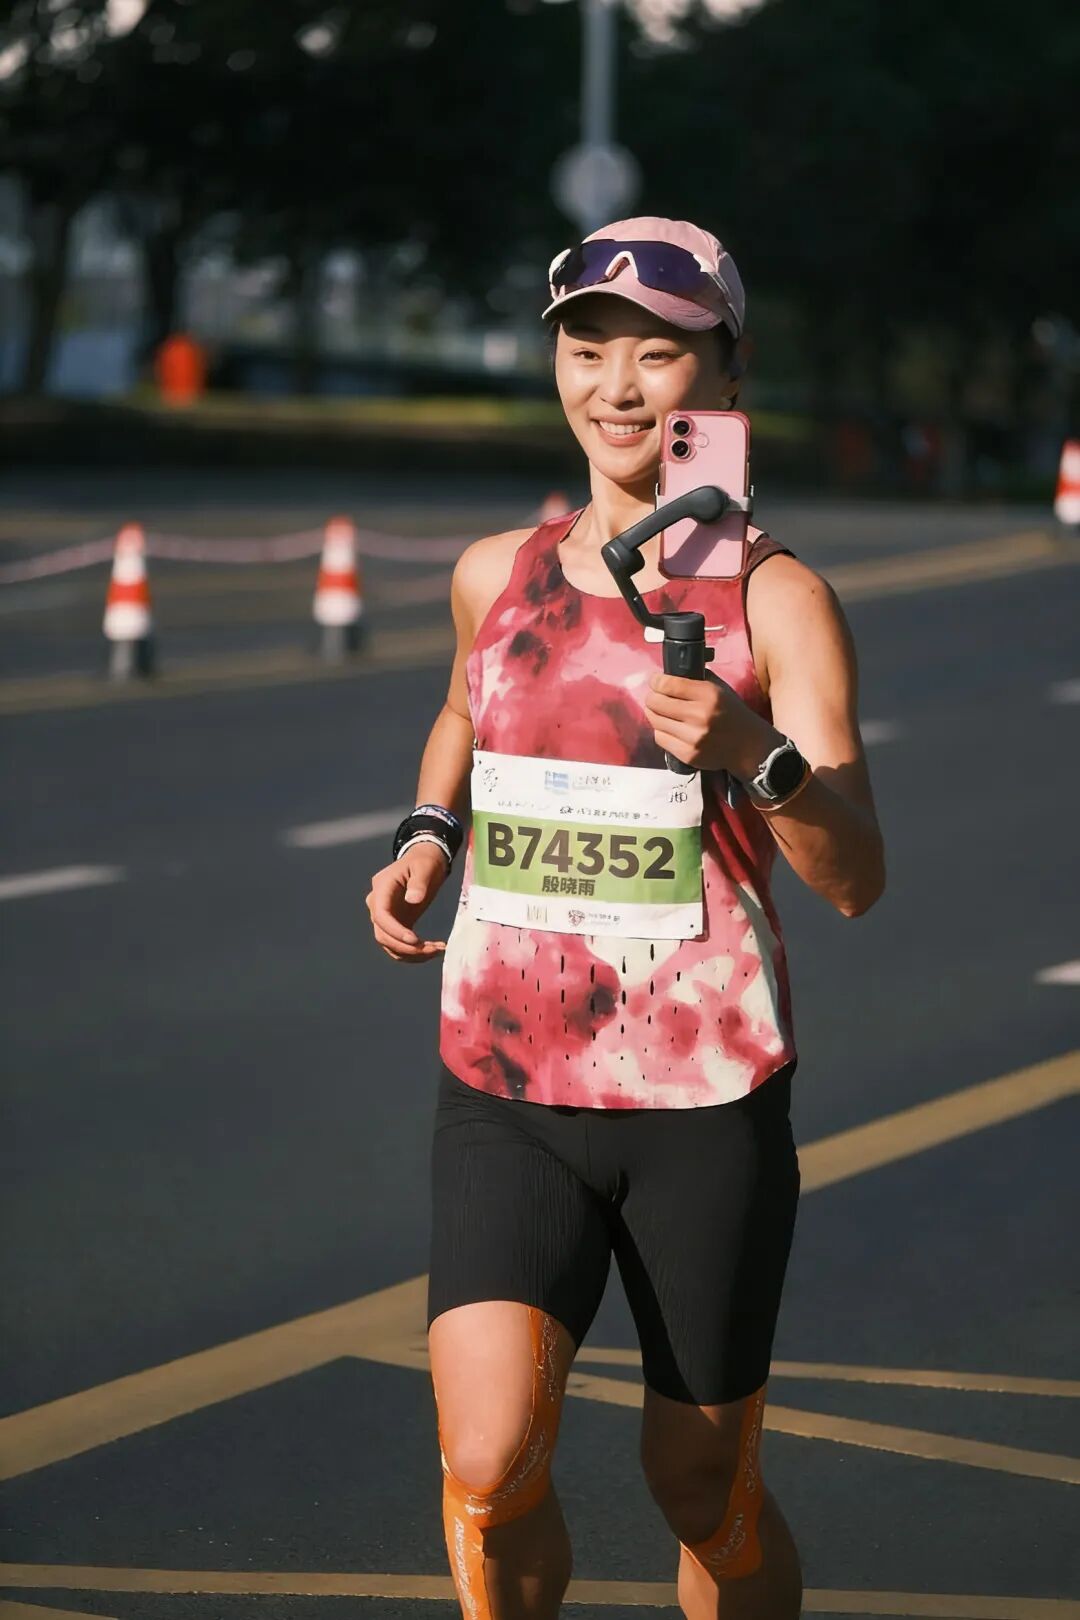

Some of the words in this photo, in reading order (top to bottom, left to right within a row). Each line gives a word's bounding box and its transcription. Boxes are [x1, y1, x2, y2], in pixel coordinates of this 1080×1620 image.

[487, 822, 675, 880] B74352
[541, 875, 596, 896] 殷晓雨
